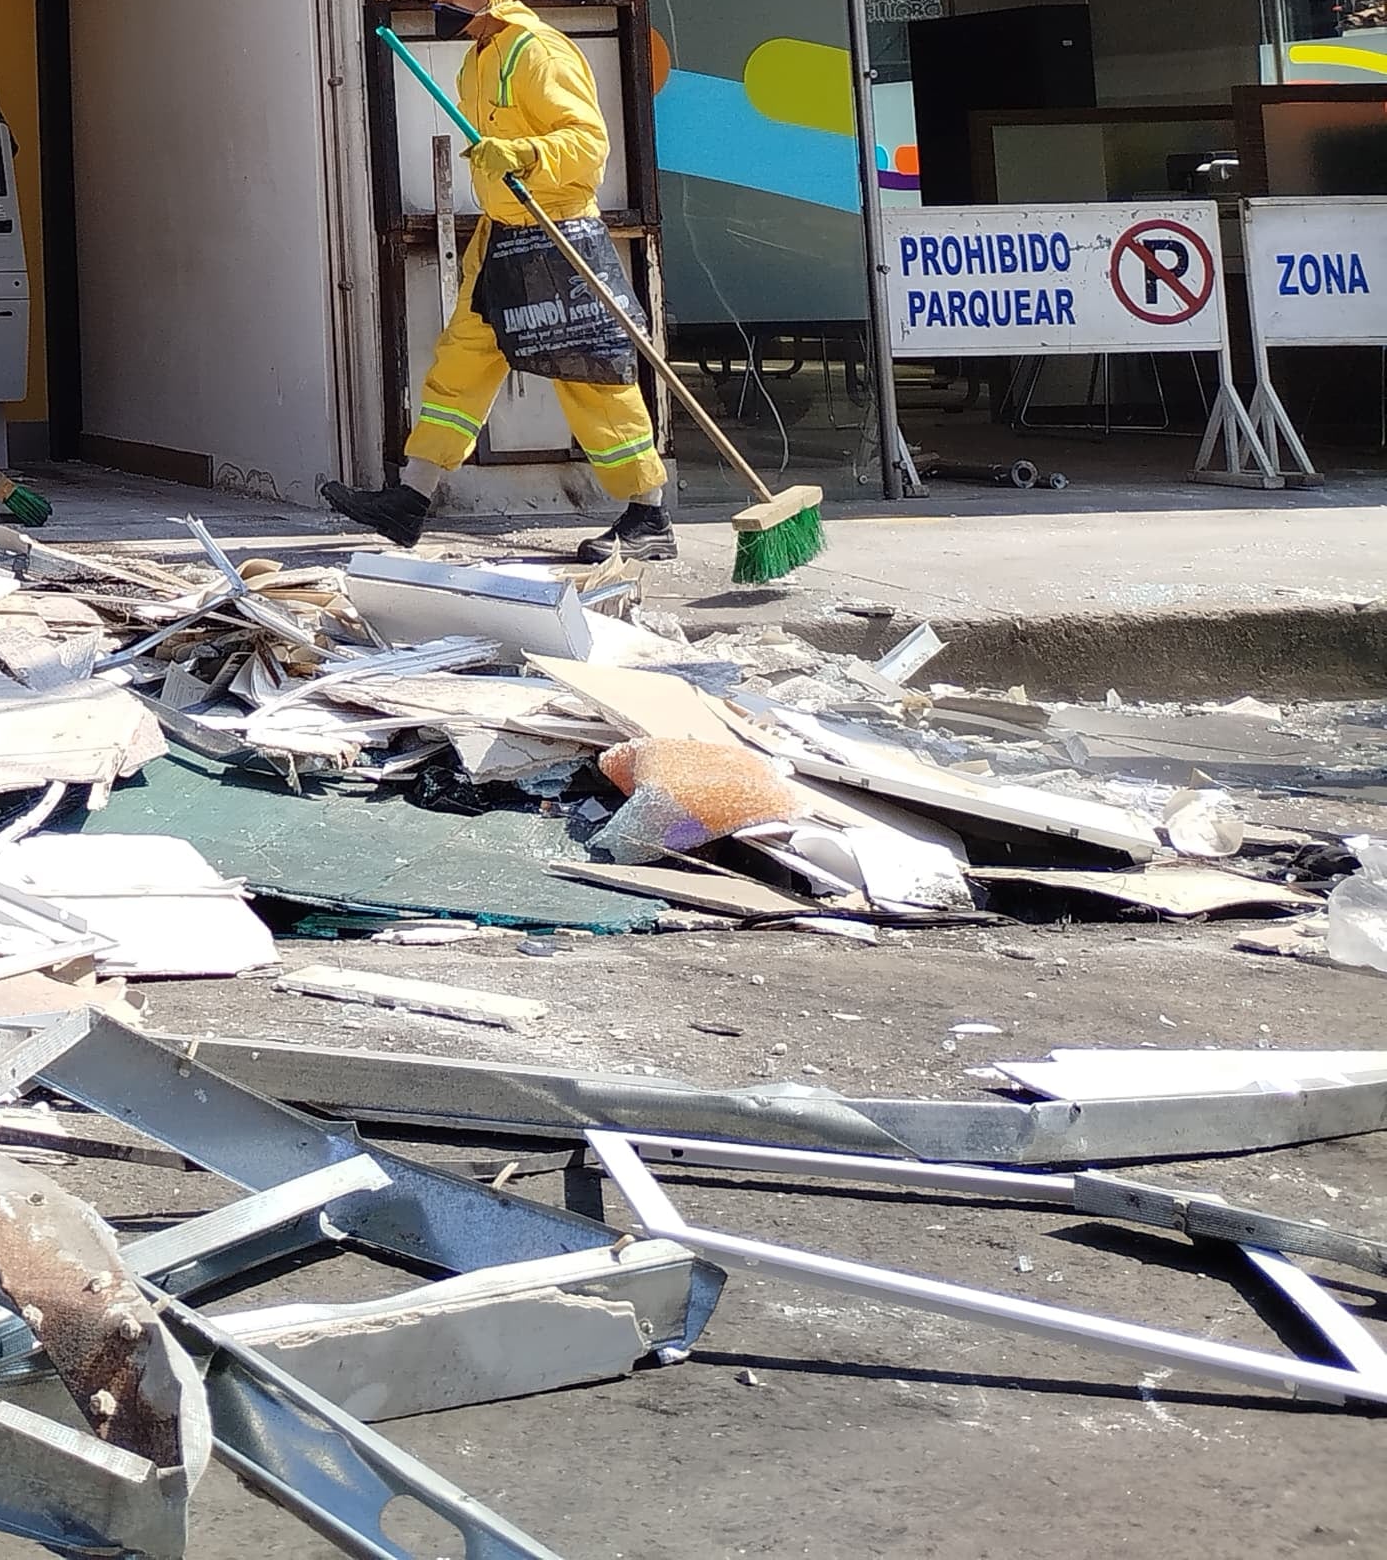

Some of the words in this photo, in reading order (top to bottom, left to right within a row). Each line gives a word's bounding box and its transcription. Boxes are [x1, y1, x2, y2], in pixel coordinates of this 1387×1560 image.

[899, 231, 1071, 276] PROHIBIDO
[1275, 253, 1370, 295] ZONA
[908, 288, 1076, 328] PARQUEAR
